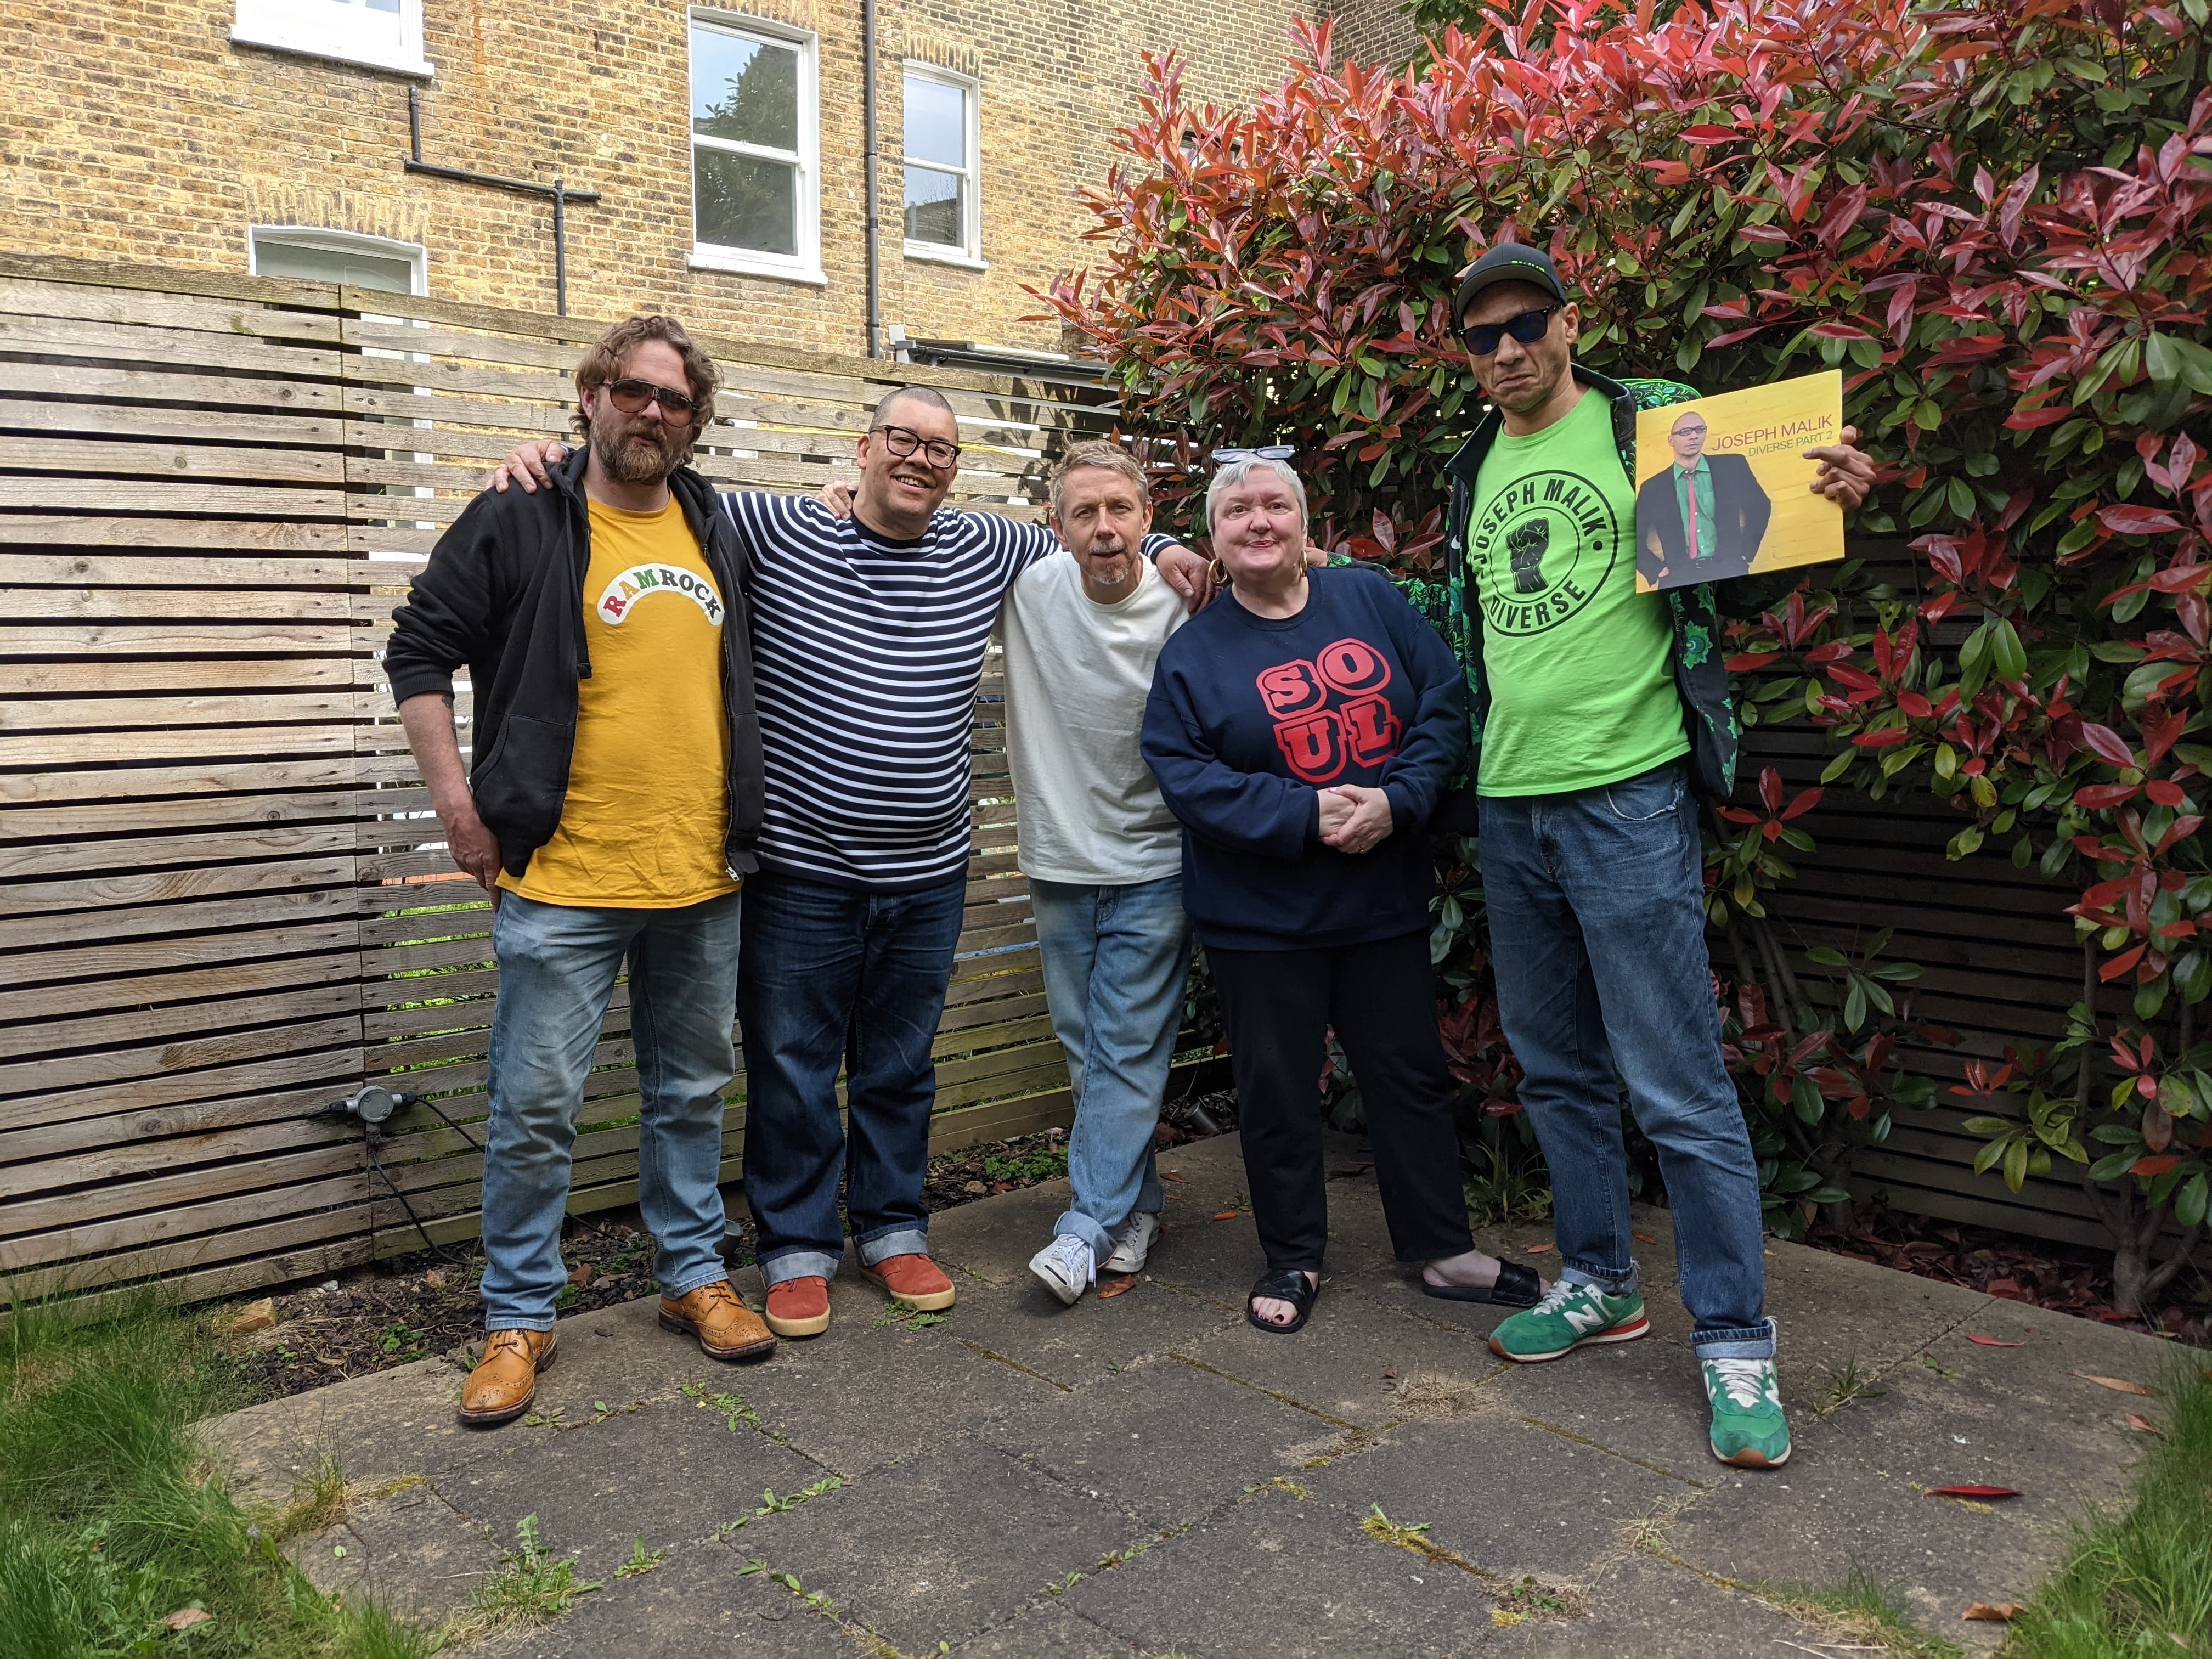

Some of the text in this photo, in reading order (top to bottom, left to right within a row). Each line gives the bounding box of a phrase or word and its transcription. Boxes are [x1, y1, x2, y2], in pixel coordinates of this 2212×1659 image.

[1711, 414, 1833, 452] JOSEPH MALIK
[1748, 431, 1833, 456] DIVERSE PART 2
[1474, 478, 1607, 565] JOSEPH MALIK
[603, 568, 721, 619] RAMROCK
[1490, 579, 1587, 629] DIVERSE
